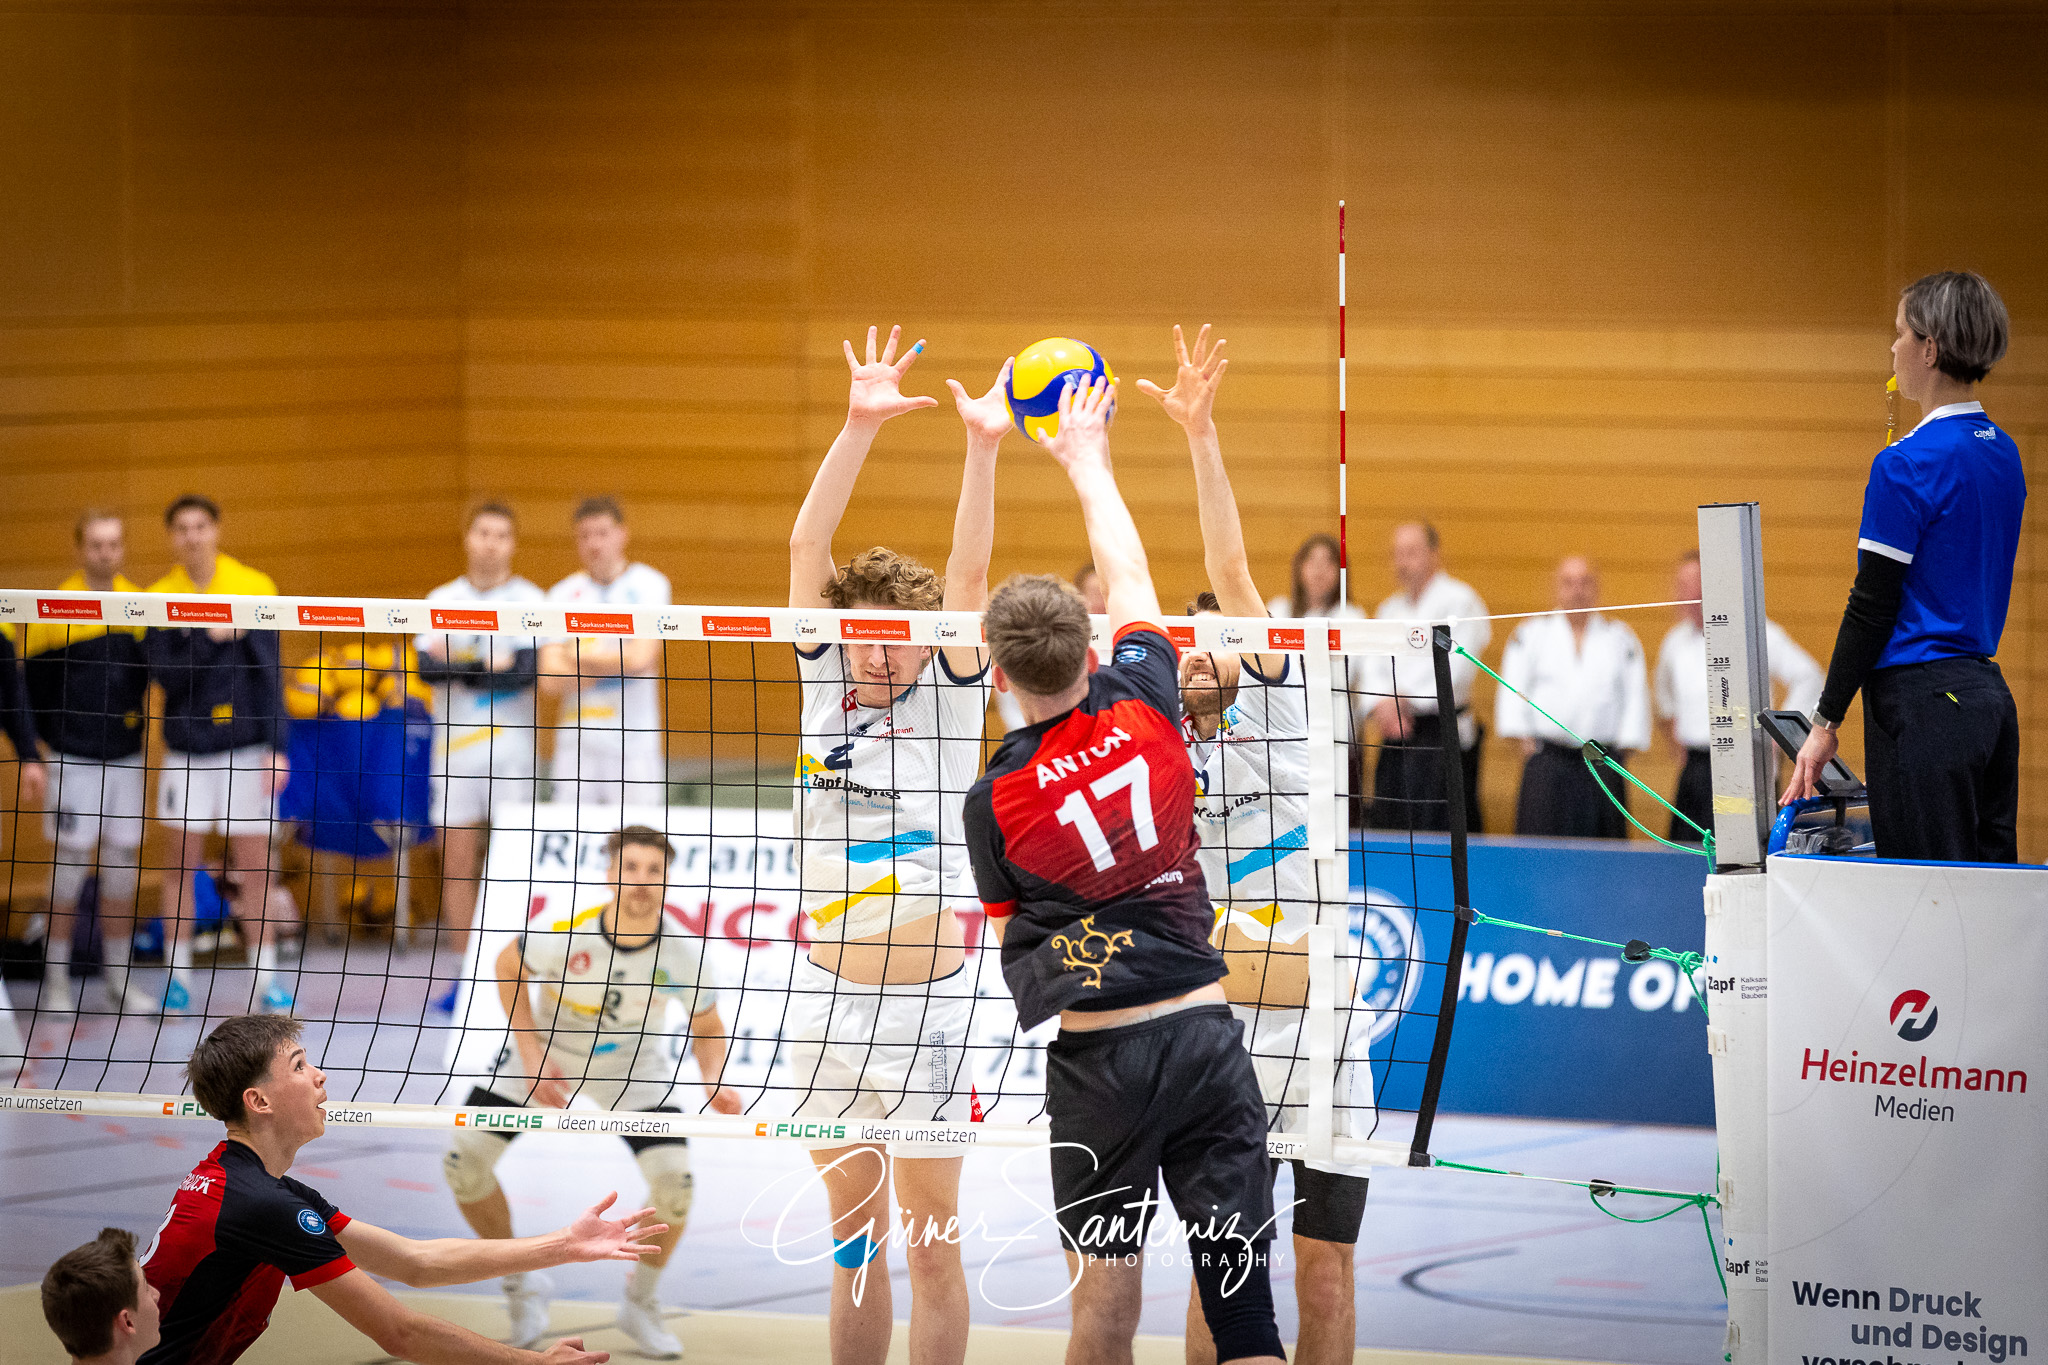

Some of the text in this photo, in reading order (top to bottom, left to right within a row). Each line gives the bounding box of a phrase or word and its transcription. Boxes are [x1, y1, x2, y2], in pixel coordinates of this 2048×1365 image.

[580, 621, 605, 629] Sparkasse
[663, 623, 678, 631] Zapf
[716, 624, 766, 633] Sparkasse Nürnberg
[801, 626, 817, 634] Zapf
[941, 630, 957, 638] Zapf
[1226, 636, 1243, 644] Zapf
[813, 774, 842, 791] Zapf
[1054, 754, 1160, 873] 17
[1457, 951, 1620, 1009] HOME
[1707, 975, 1736, 993] Zapf
[1801, 1047, 2028, 1094] Heinzelmann
[16, 1097, 83, 1111] umsetzen
[1874, 1094, 1955, 1122] Medien
[475, 1113, 670, 1134] FUCHS Ideen umsetzen
[775, 1123, 977, 1143] FUCHS Ideen umsetzen
[1725, 1258, 1750, 1276] Zapf
[1791, 1280, 1983, 1319] Wenn Druck
[1851, 1321, 2028, 1364] und Design
